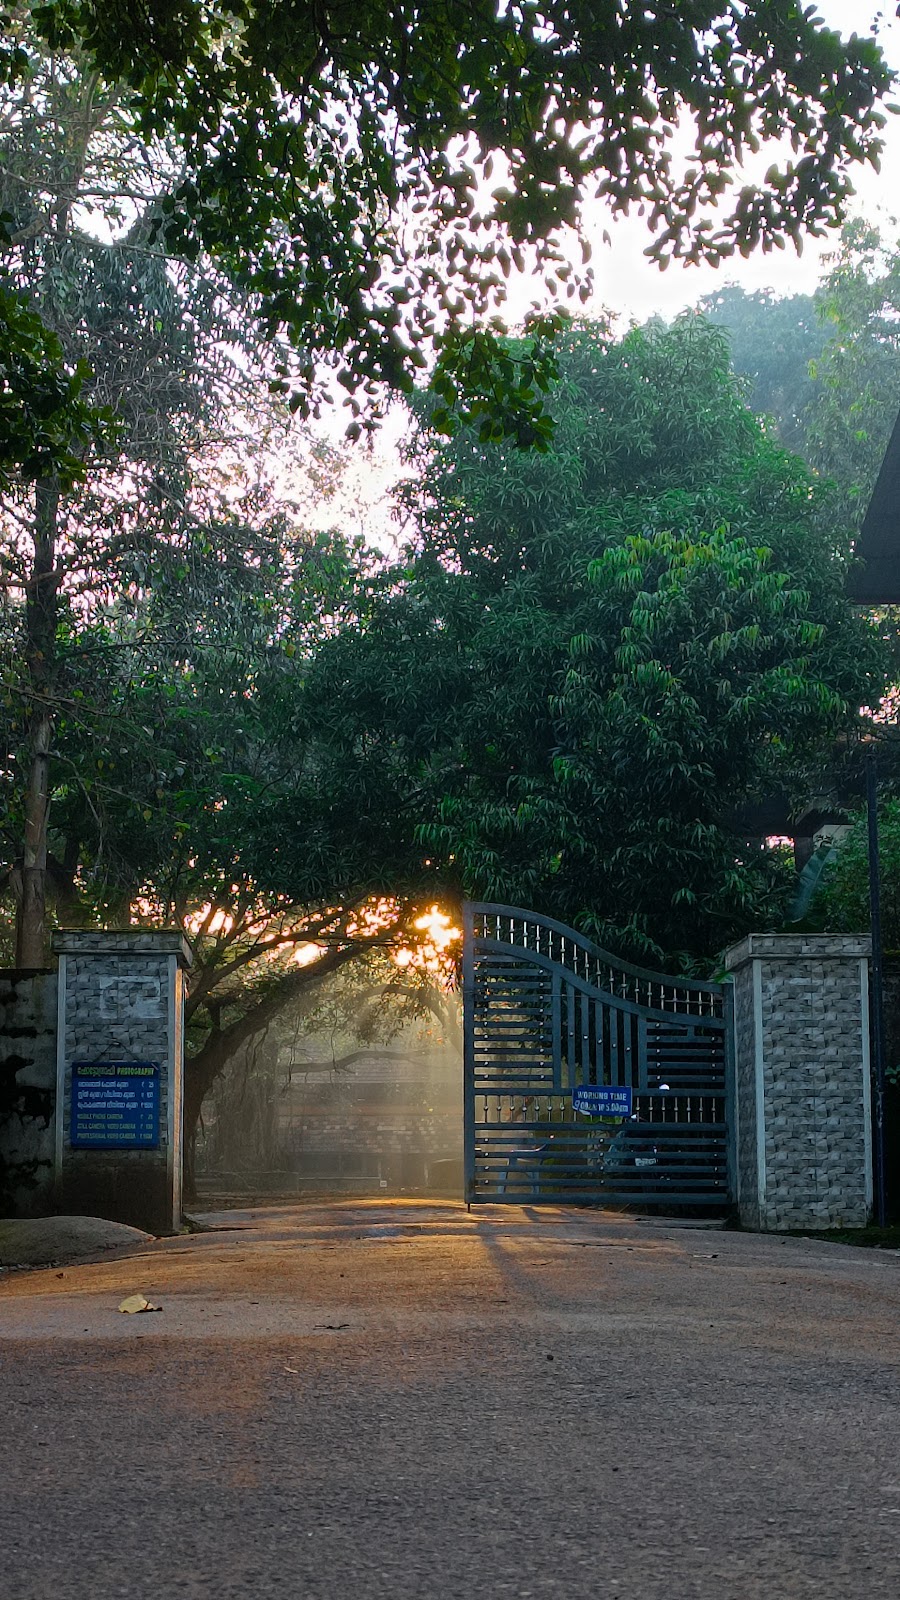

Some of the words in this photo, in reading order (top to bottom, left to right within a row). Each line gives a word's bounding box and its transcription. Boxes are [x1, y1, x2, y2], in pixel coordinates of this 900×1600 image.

[117, 1067, 154, 1075] PHOTOGRAPHY
[577, 1091, 608, 1100] WORKING
[610, 1092, 627, 1101] TIME
